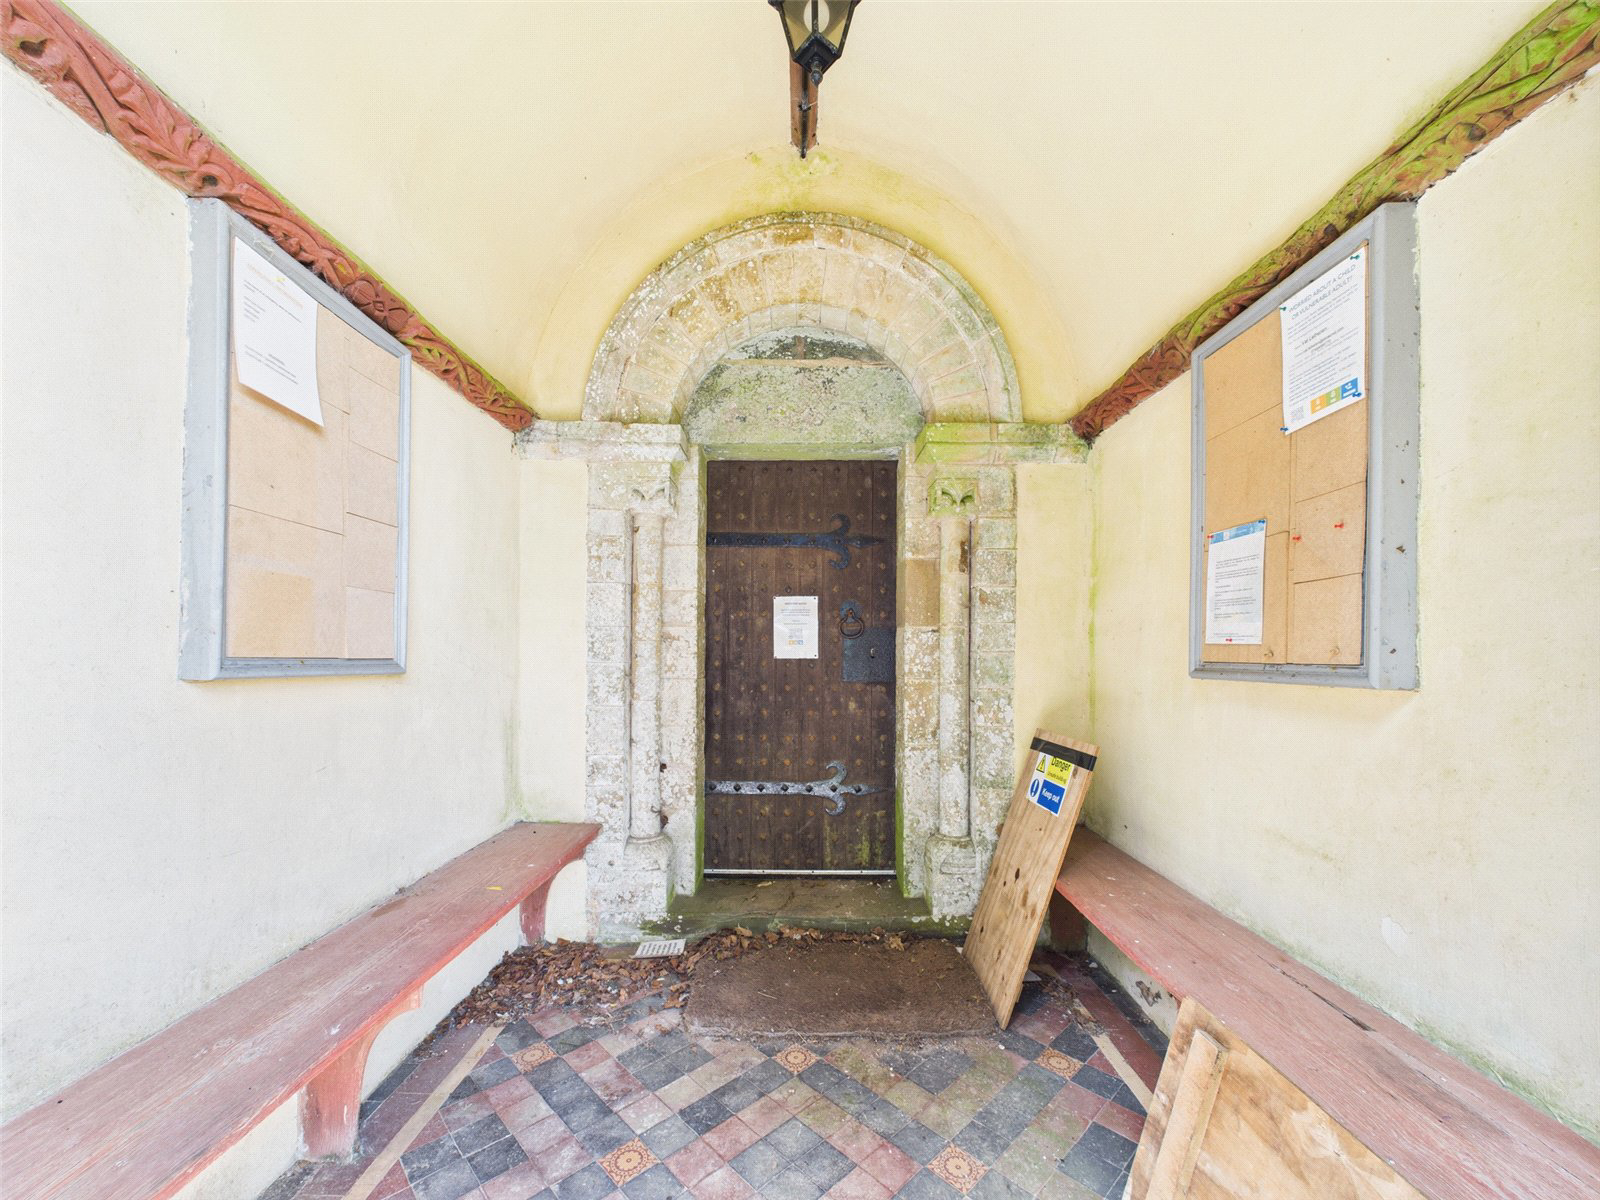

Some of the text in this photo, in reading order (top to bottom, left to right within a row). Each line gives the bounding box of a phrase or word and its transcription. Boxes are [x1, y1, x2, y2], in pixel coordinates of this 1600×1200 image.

[1289, 294, 1312, 312] WORRIED
[1313, 280, 1331, 296] ABOUT
[1338, 264, 1356, 279] CHILD
[1051, 756, 1071, 772] Danger
[1042, 788, 1052, 800] Keep
